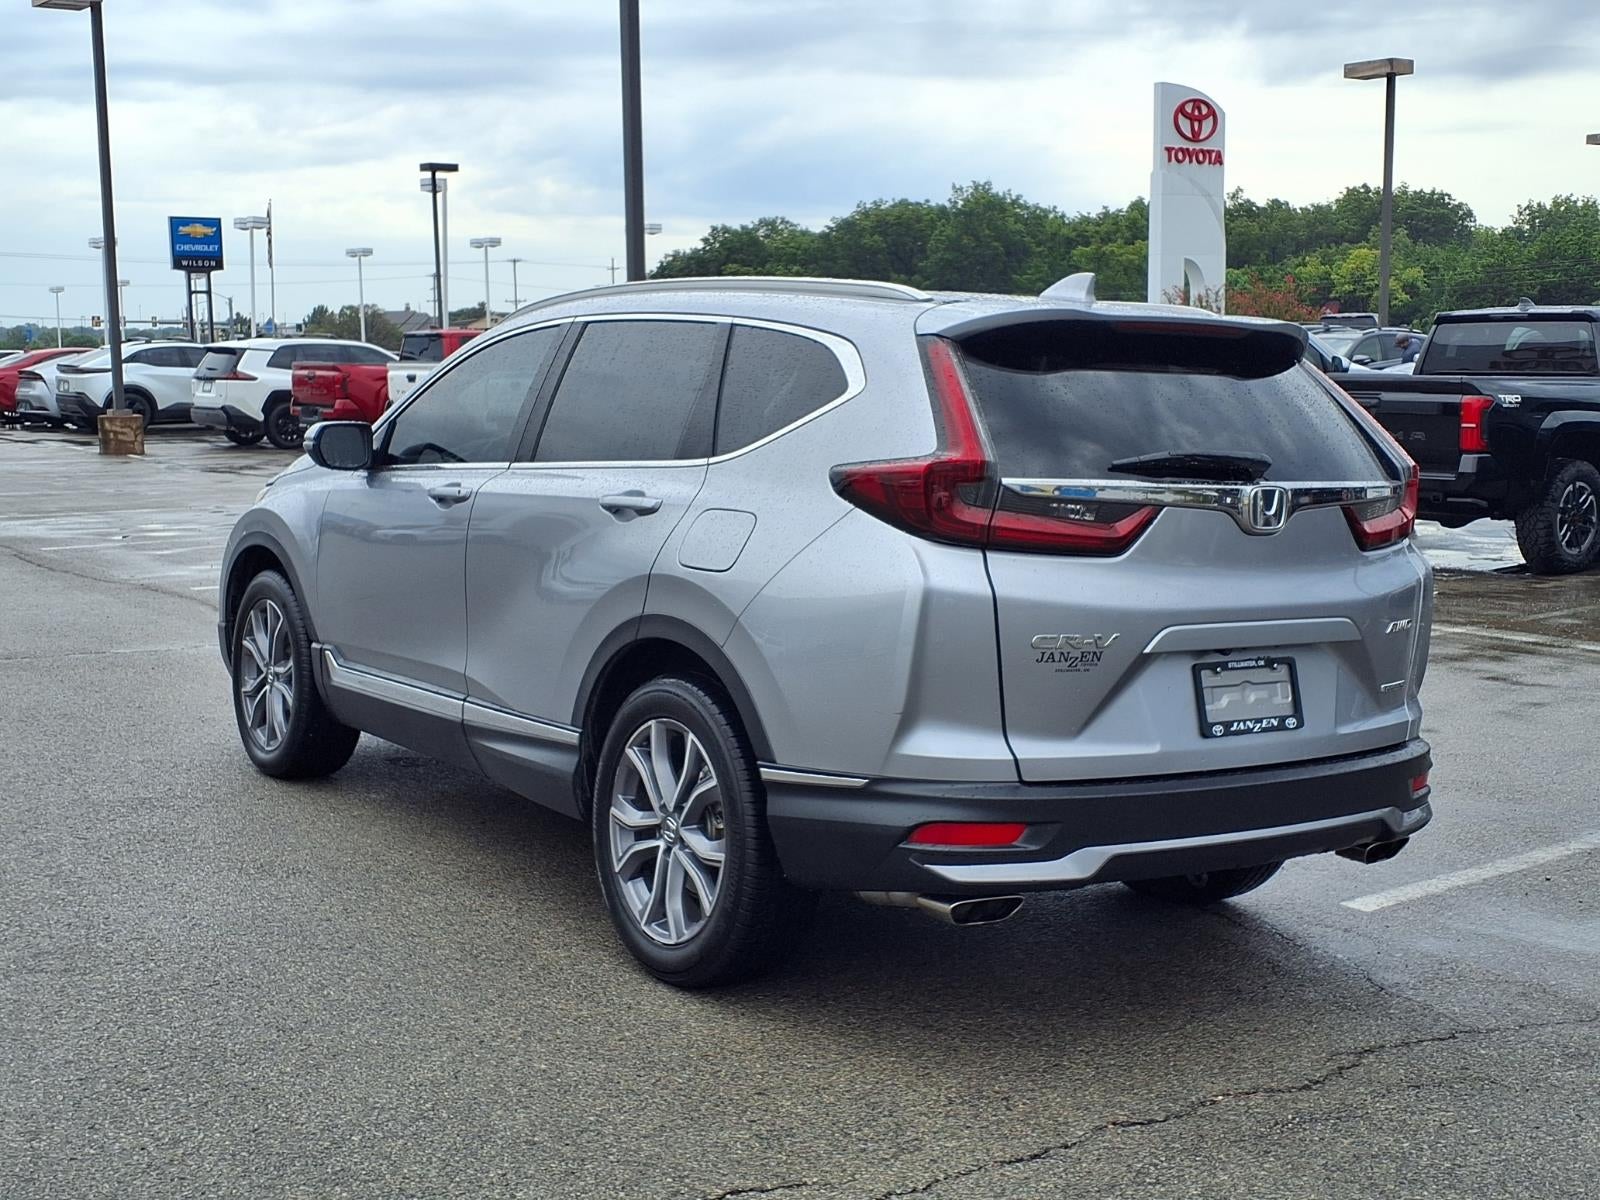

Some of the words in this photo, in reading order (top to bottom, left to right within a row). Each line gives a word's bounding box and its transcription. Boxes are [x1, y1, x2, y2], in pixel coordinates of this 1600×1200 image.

[1164, 146, 1223, 166] TOYOTA
[176, 244, 219, 252] CHEVROLET
[1498, 394, 1521, 404] TRD
[1031, 633, 1120, 650] CR-V
[1036, 651, 1104, 669] JANZEN
[1230, 718, 1280, 732] JANZEN
